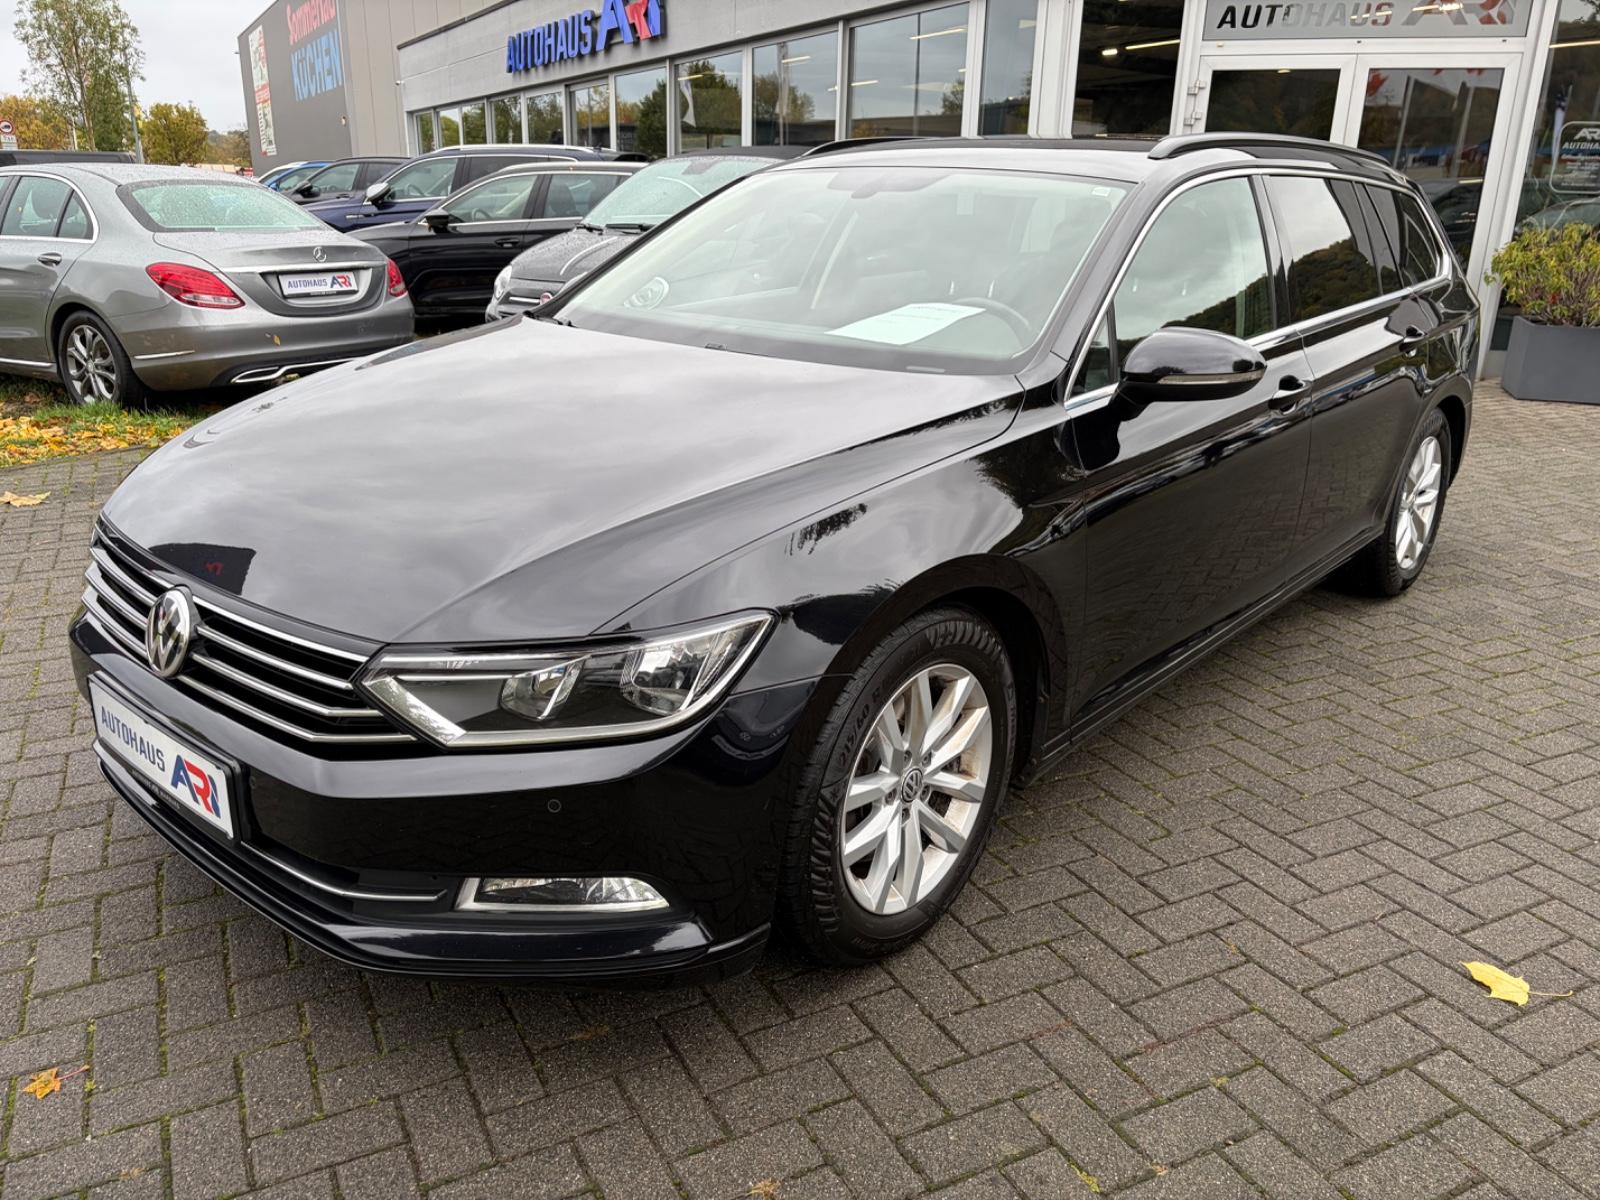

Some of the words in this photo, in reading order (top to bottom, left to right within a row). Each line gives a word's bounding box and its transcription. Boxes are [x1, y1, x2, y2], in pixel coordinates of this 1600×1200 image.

[506, 10, 594, 73] AUTOHAUS
[1217, 1, 1393, 29] AUTOHAUS
[291, 29, 342, 102] KÜCHEN
[288, 279, 328, 289] AUTOHAUS
[330, 274, 352, 288] ARI
[101, 705, 166, 773] AUTOHAUS
[170, 754, 222, 819] ARI
